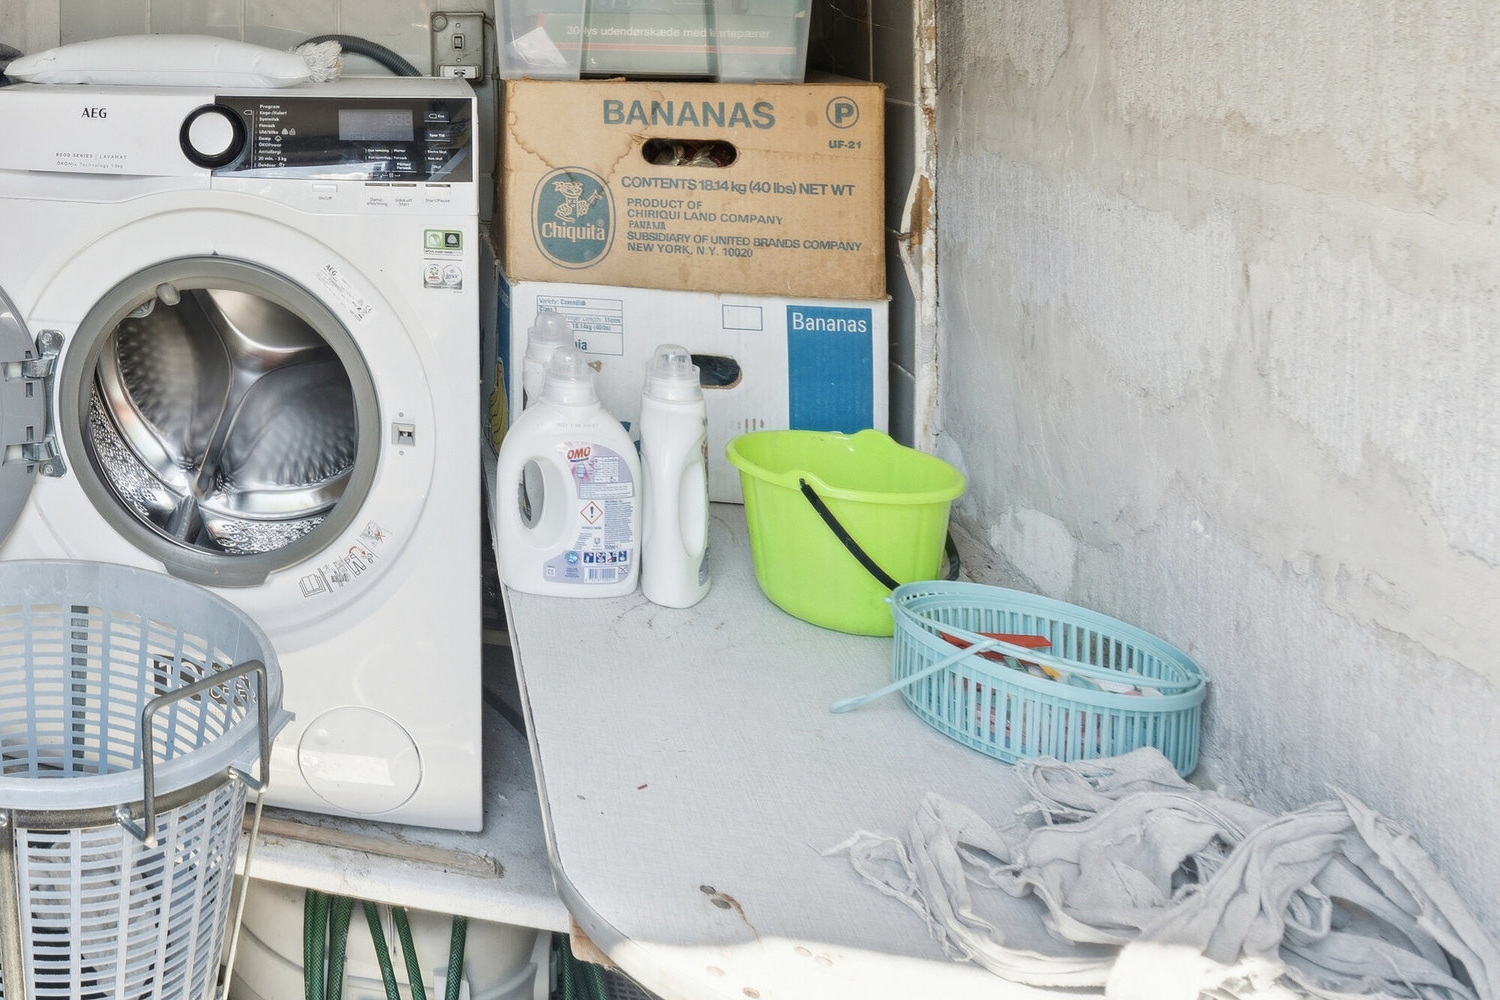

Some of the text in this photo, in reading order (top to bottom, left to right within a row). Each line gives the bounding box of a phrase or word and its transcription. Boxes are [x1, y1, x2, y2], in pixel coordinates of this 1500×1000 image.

[600, 26, 681, 38] udendørskæde
[682, 28, 706, 38] med
[81, 107, 107, 119] AEG
[603, 99, 776, 130] BANANAS
[834, 102, 854, 124] P
[828, 139, 862, 150] UF-21
[621, 175, 856, 197] CONTENTS 18.14 kg (40 lbs) NET WT
[627, 198, 703, 210] PRODUCT OF
[627, 209, 783, 225] CHIRIQUI LAND COMPANY
[541, 221, 606, 243] Chiquita
[628, 220, 666, 230] PANAMA
[627, 231, 862, 252] SUBSIDIARY OF UNITED BRANDS COMPANY
[627, 242, 754, 257] NEW YORK, N.Y. 10020
[325, 263, 338, 277] AEG
[792, 312, 868, 335] Bananas
[566, 446, 591, 460] OMO
